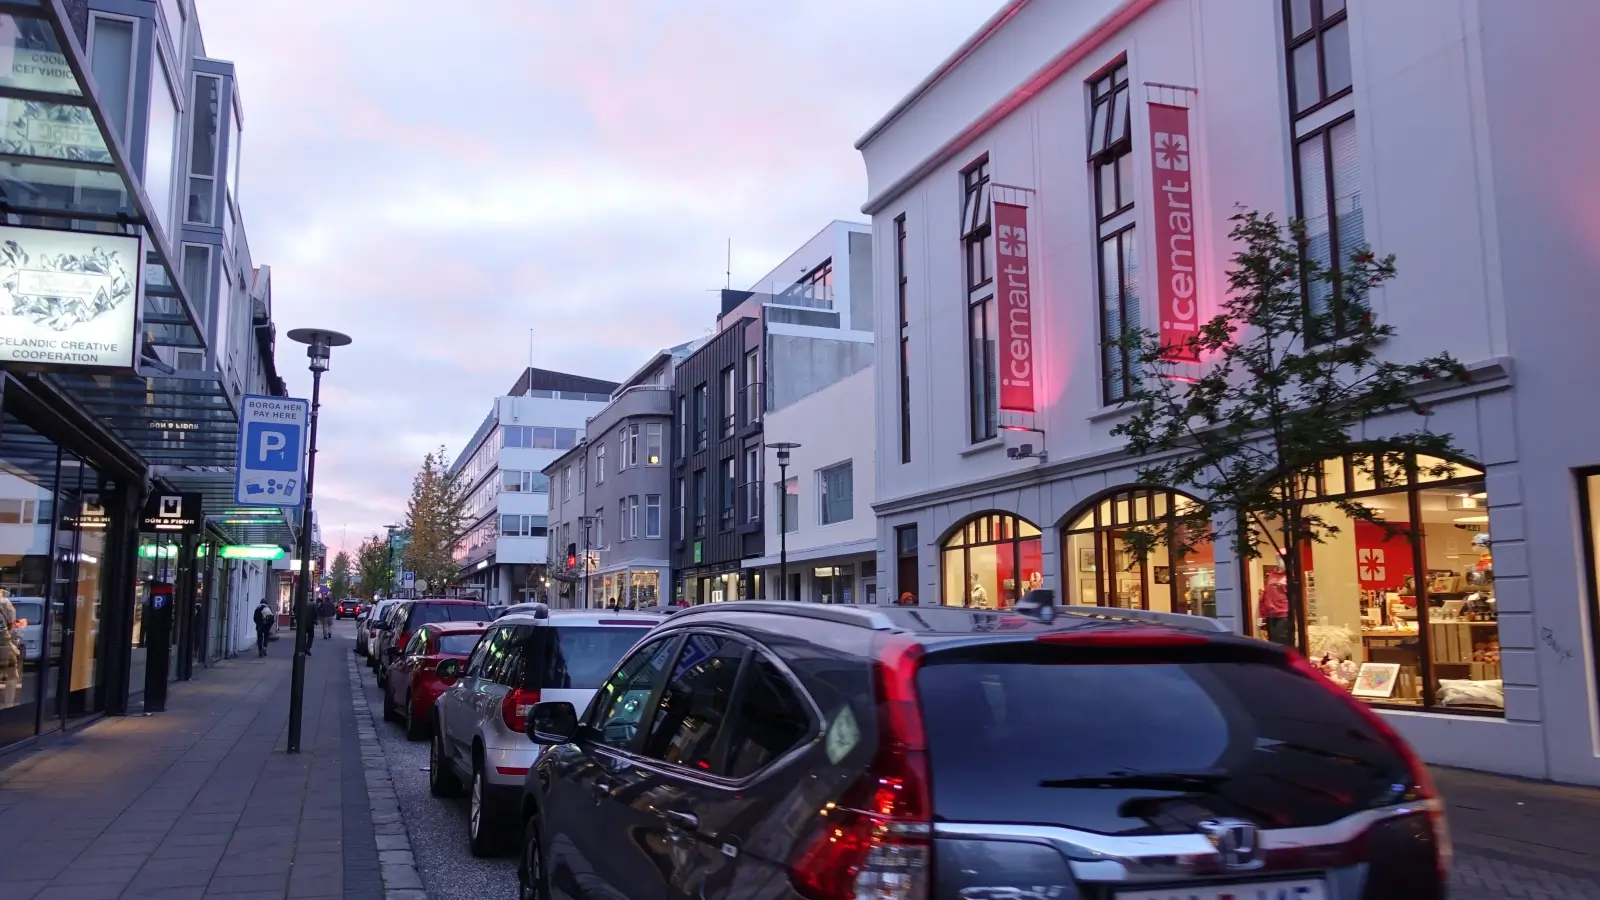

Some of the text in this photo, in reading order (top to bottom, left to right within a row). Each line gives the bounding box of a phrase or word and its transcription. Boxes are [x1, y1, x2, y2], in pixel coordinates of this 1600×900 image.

[1162, 179, 1195, 332] icemart
[1000, 264, 1030, 387] icemart
[12, 349, 98, 362] COOPERATION
[61, 341, 118, 352] CREATIVE
[249, 401, 281, 410] BORGA
[259, 430, 287, 462] P
